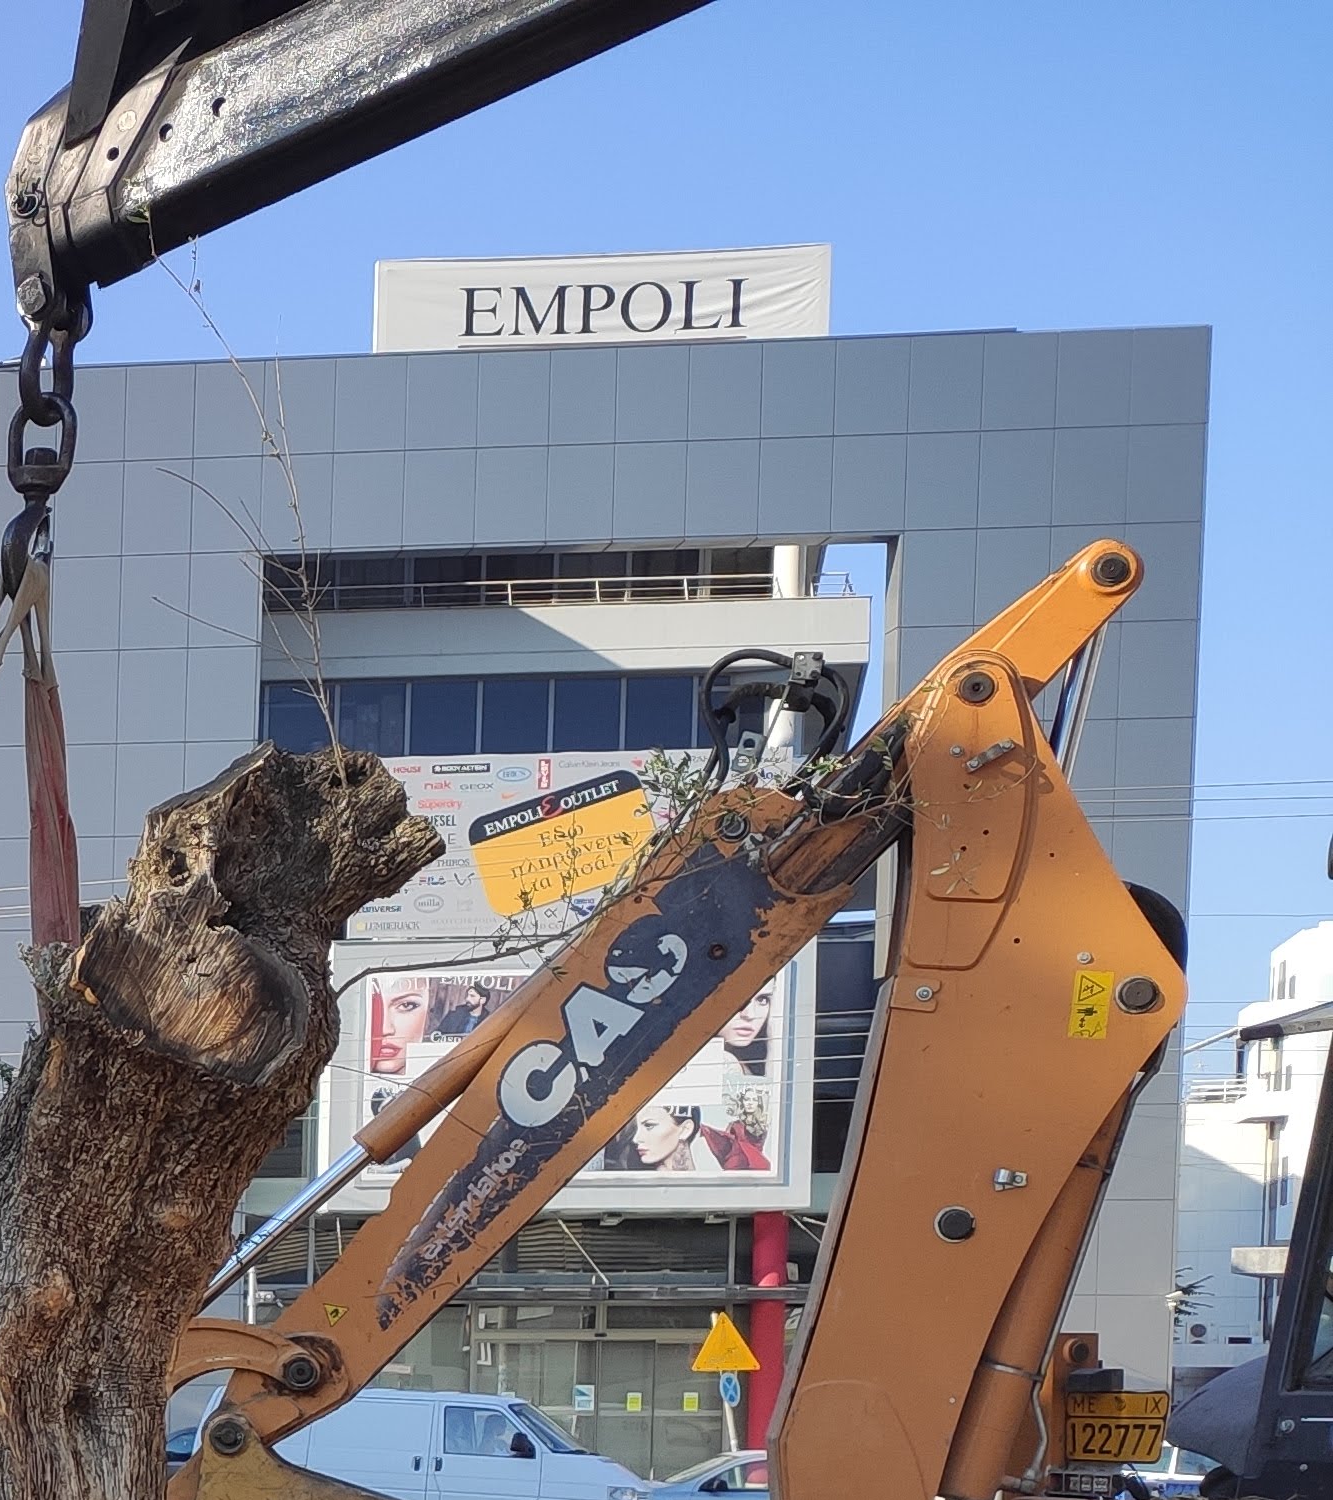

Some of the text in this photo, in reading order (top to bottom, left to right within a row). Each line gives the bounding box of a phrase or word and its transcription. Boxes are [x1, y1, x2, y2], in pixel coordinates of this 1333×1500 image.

[458, 278, 749, 337] EMPOLI
[424, 780, 452, 790] nak
[460, 782, 494, 790] GEOX
[417, 800, 464, 811] Superdry
[483, 806, 544, 837] EMPOLI
[560, 779, 620, 810] OUTLET
[1073, 1397, 1163, 1414] ME IX
